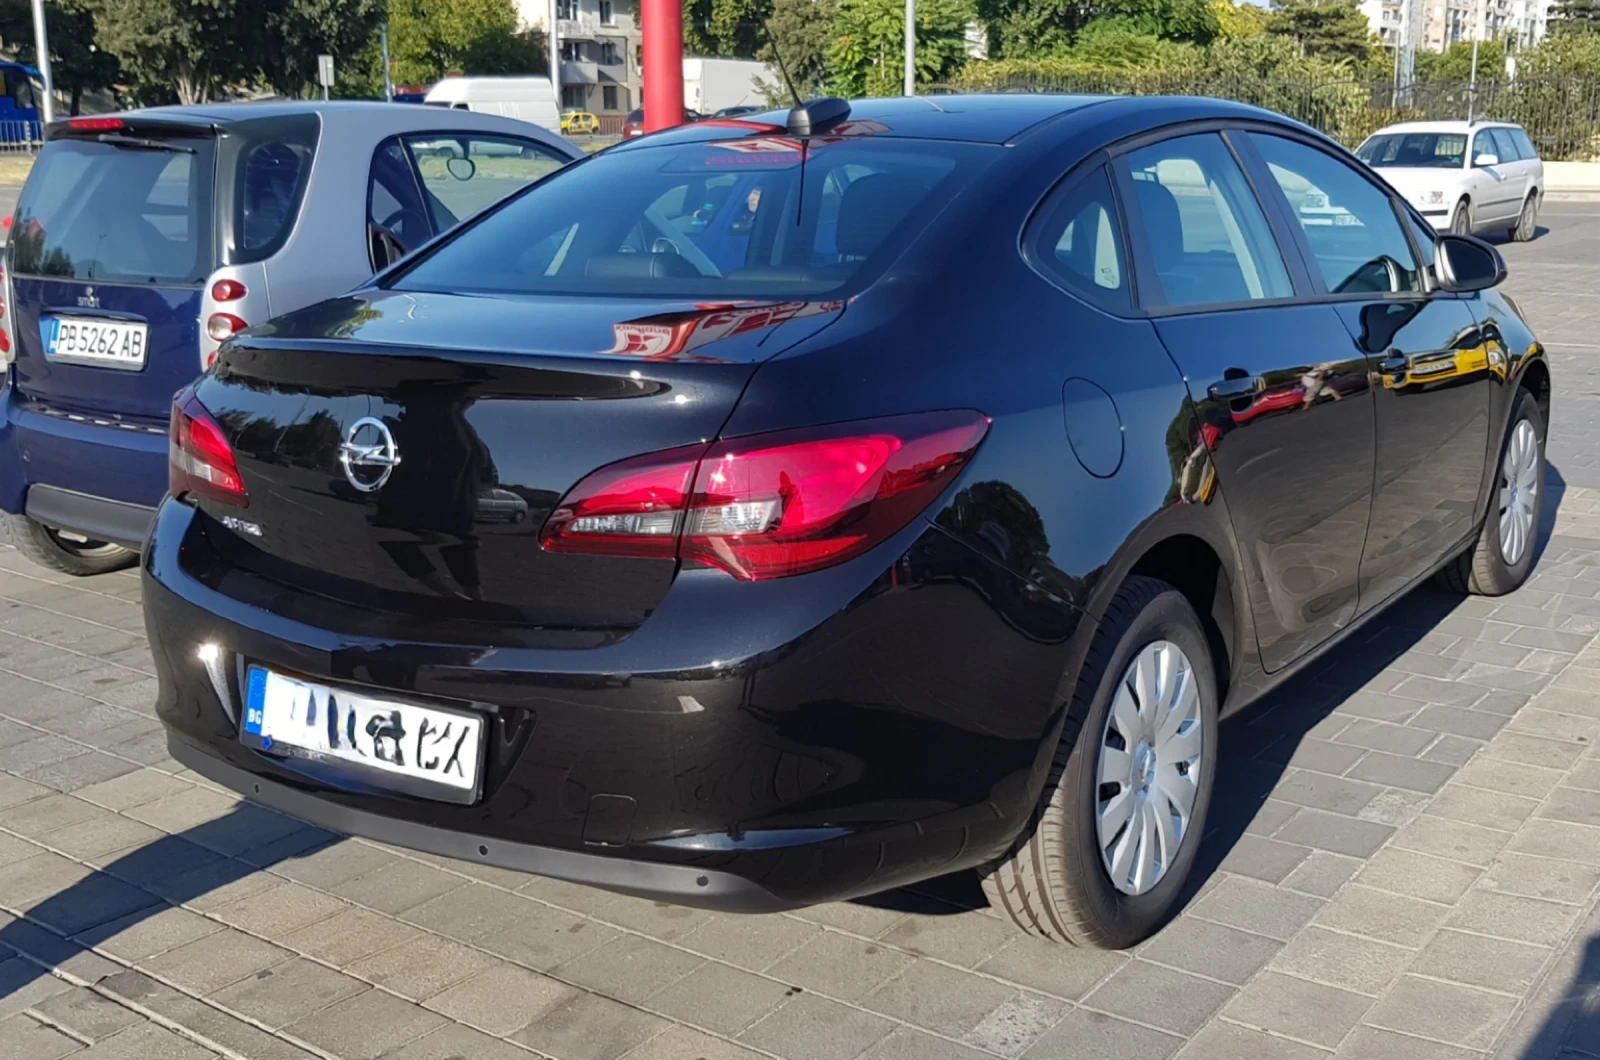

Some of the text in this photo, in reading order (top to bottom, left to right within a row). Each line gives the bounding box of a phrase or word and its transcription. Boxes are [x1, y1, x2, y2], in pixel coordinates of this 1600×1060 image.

[79, 326, 118, 354] 5262
[120, 330, 142, 357] AB
[248, 708, 262, 725] BG
